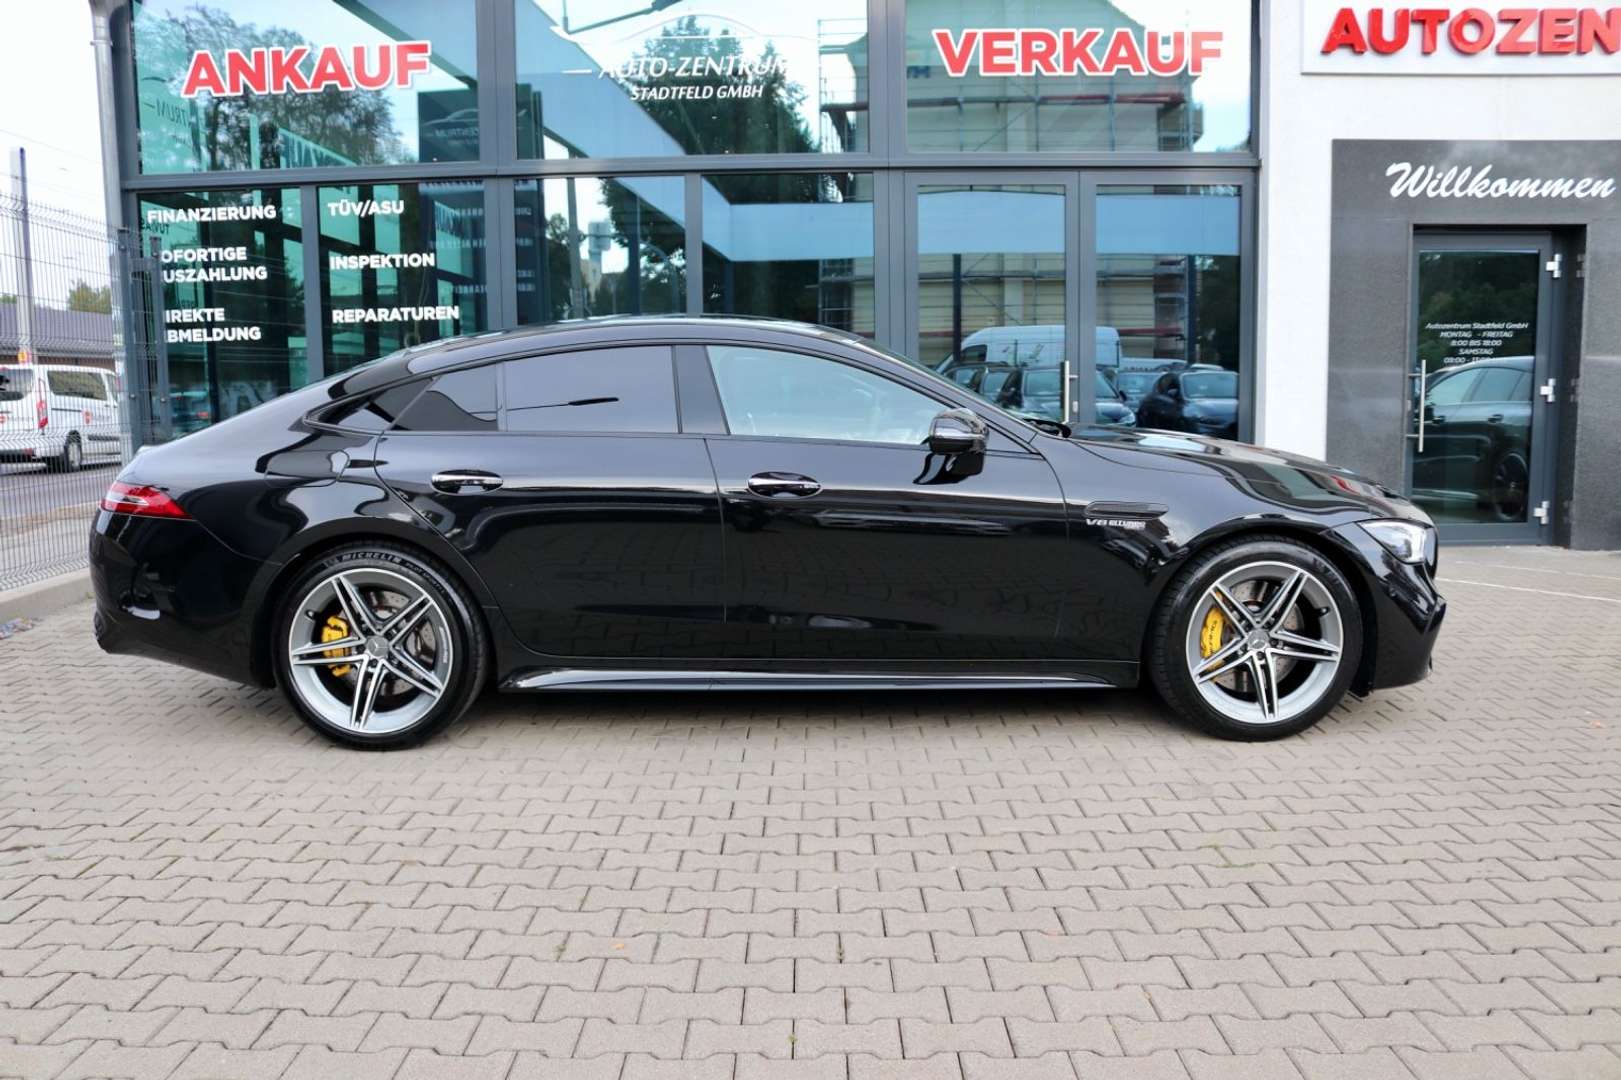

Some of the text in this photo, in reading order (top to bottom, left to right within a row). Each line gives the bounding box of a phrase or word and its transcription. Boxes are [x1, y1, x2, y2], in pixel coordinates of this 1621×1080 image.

[932, 28, 1223, 77] VERKAUF
[181, 40, 432, 98] ANKAUF
[630, 84, 764, 101] STADTFELD GMBH
[1385, 162, 1616, 199] Willkommen
[147, 204, 277, 224] FINANZIERUNG
[327, 199, 405, 218] TÜV/ASU
[160, 246, 248, 264] OFORTIGE
[329, 252, 436, 271] INSPEKTION
[162, 265, 268, 285] USZAHLUNG
[165, 307, 226, 324] IREKTE
[331, 305, 460, 324] REPARATUREN
[166, 326, 262, 344] BMELDUNG
[1440, 330, 1472, 338] MONTAG
[1481, 330, 1513, 338] FREITAG
[1506, 322, 1529, 330] GmbH
[1458, 347, 1494, 355] SAMSTAG
